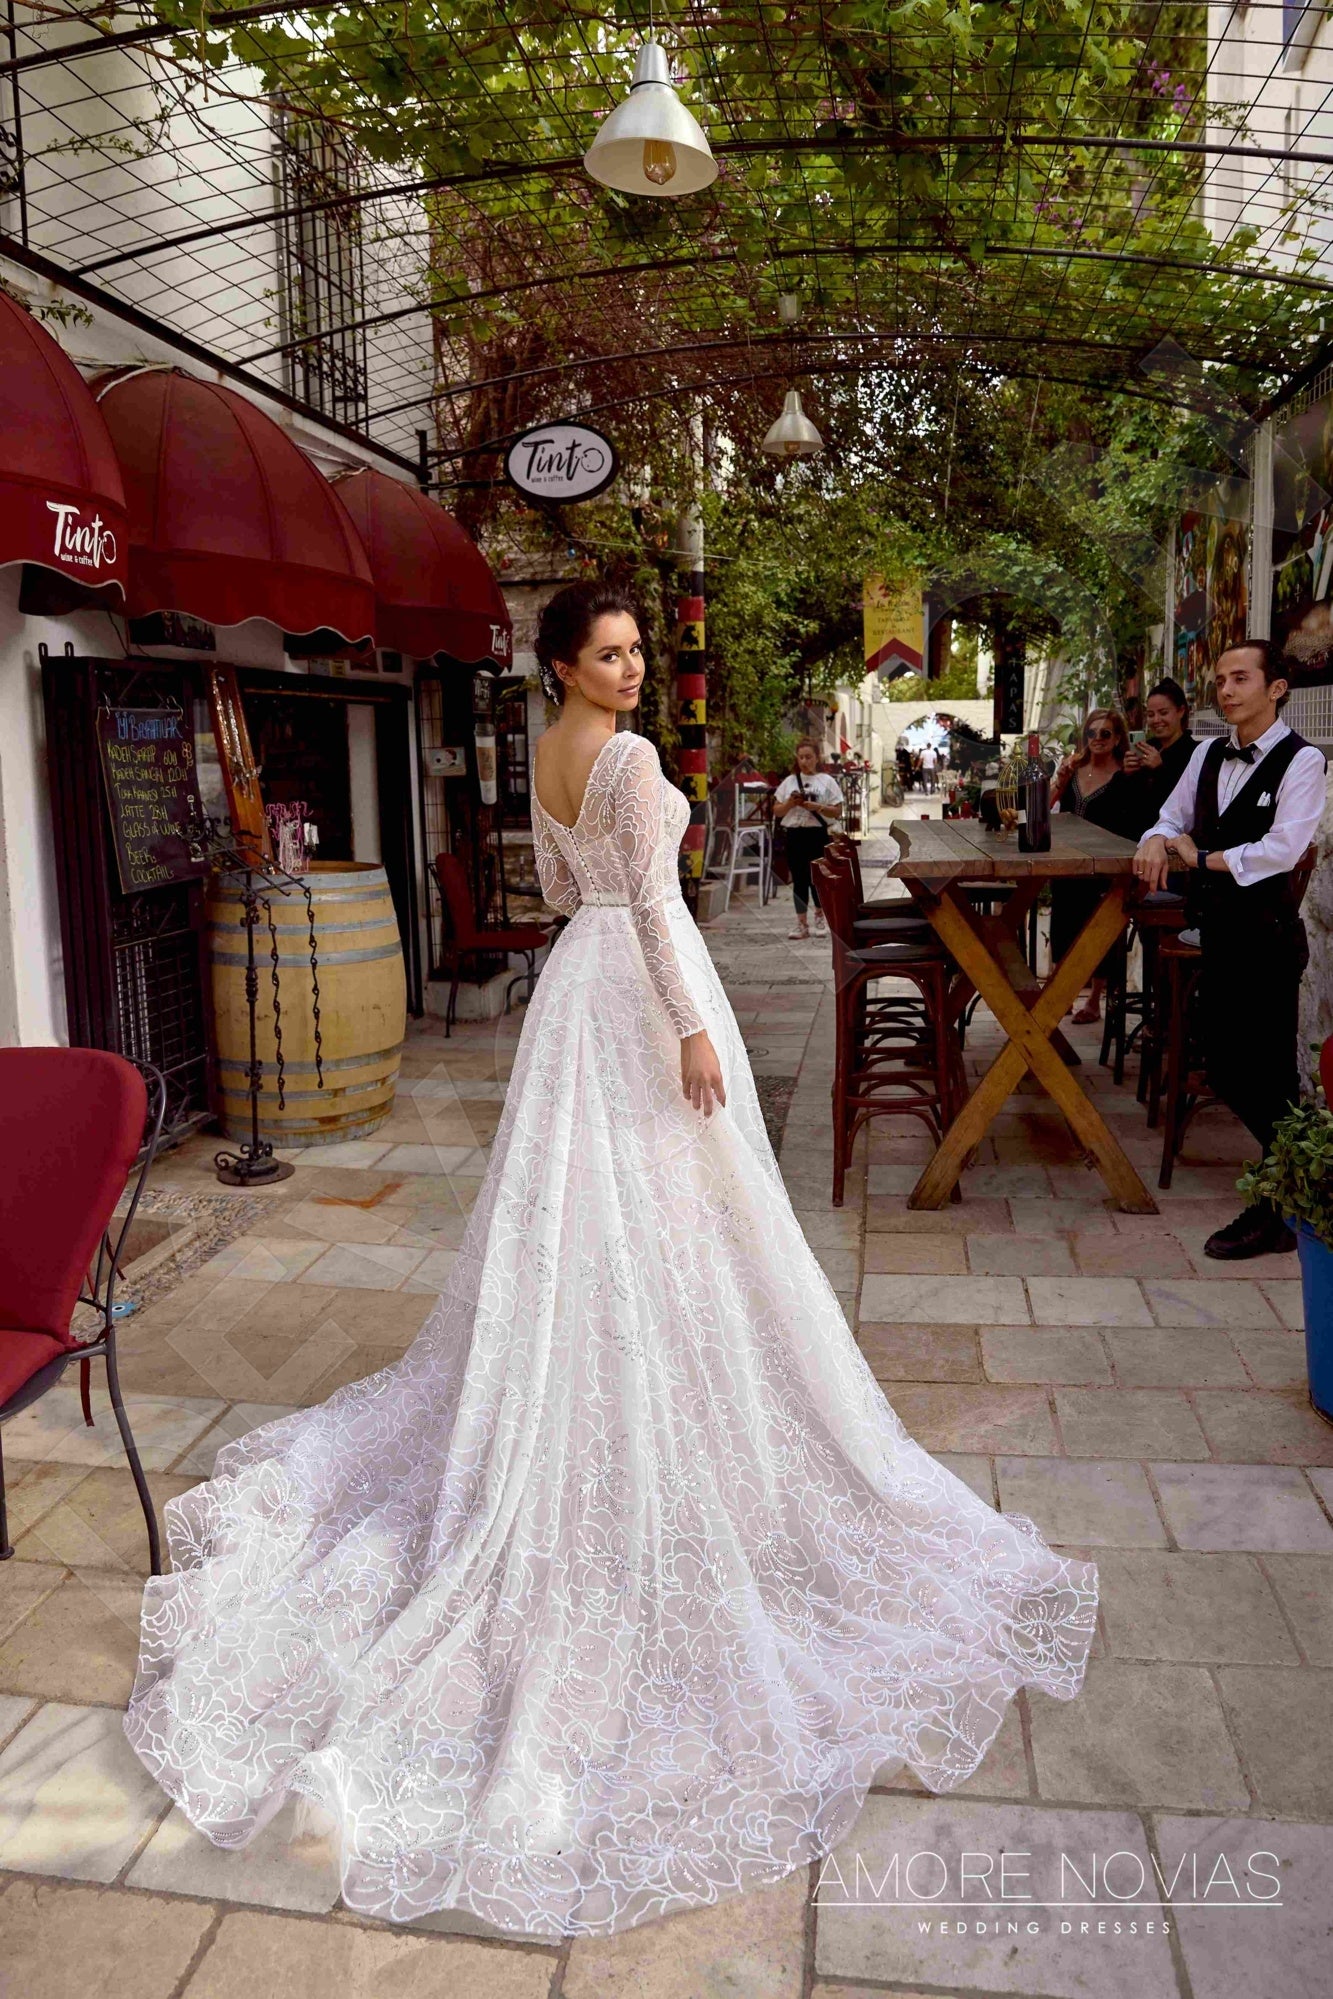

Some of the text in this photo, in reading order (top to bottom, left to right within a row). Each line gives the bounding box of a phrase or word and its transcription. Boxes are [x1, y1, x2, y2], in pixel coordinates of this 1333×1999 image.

[522, 439, 604, 481] Tinto
[46, 500, 116, 568] Tinto
[1008, 657, 1018, 728] TAPAS
[121, 804, 144, 818] LATTE
